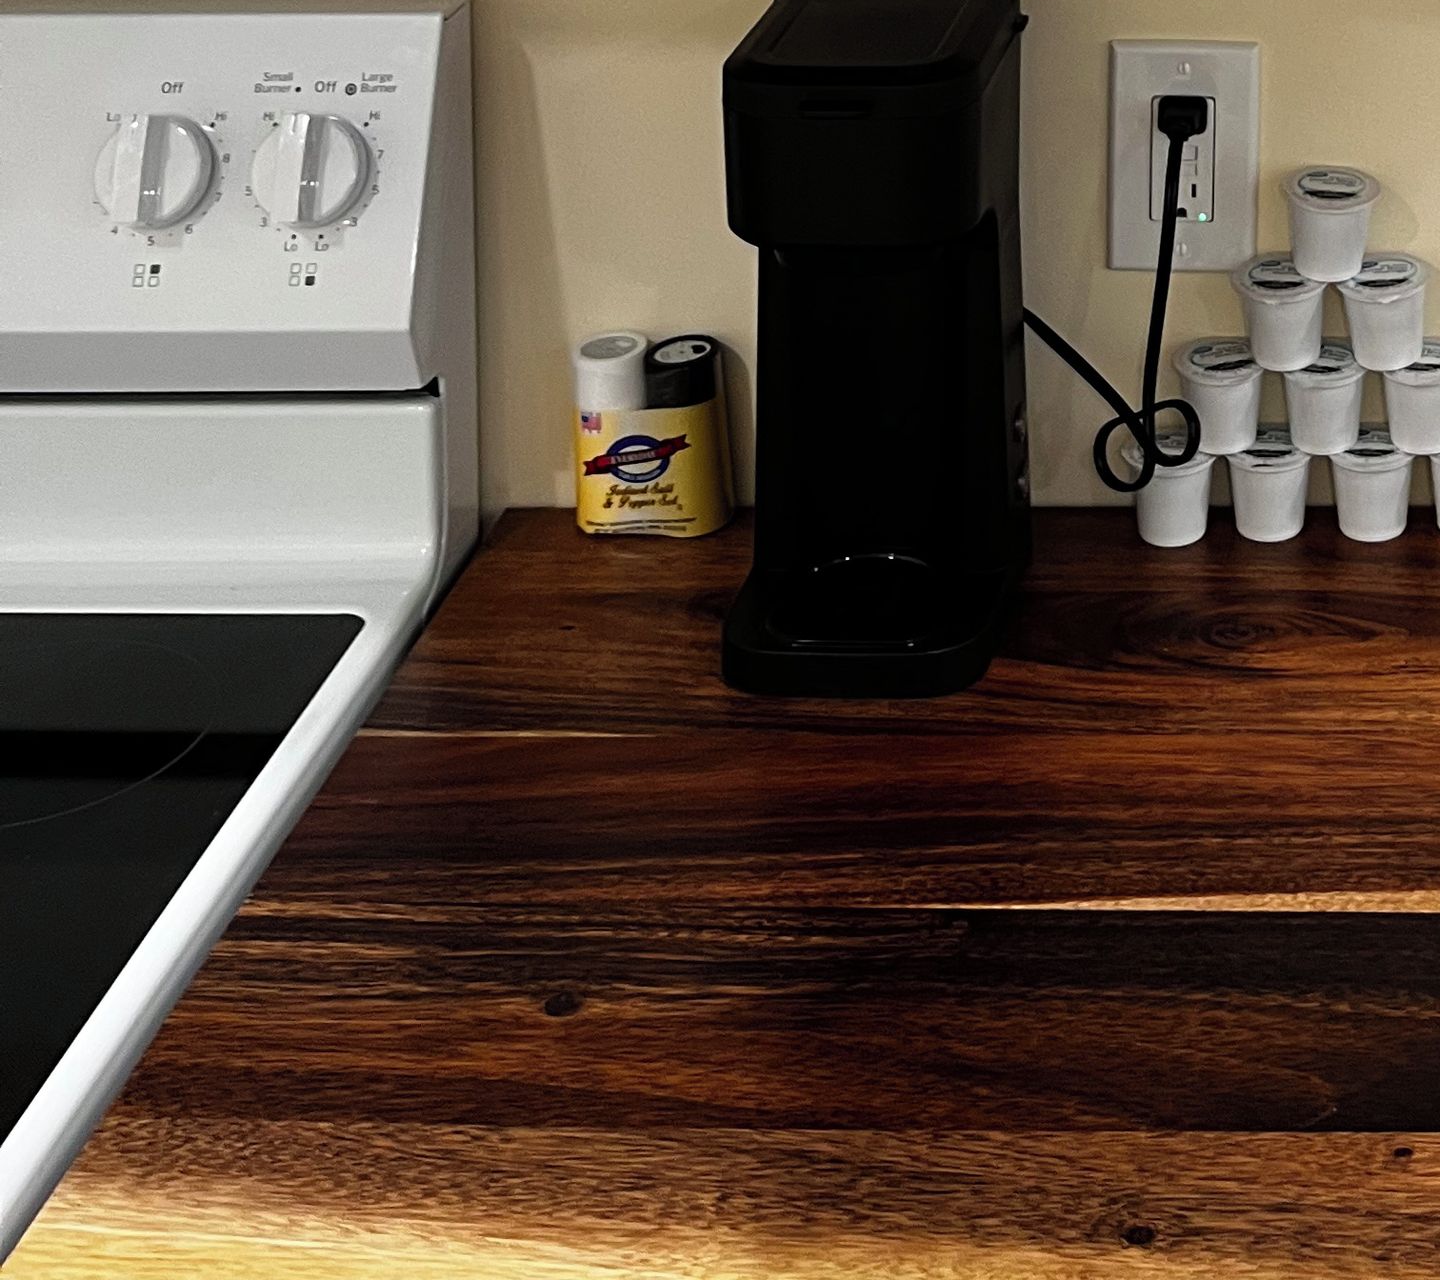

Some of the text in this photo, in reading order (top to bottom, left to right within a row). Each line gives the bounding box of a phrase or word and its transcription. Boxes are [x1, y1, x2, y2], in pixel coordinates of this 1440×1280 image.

[263, 72, 294, 82] Small
[362, 72, 394, 83] Large
[161, 81, 184, 94] Off
[254, 83, 292, 93] Burner
[314, 80, 338, 93] Off
[360, 83, 398, 93] Burner
[369, 110, 381, 120] Hi
[377, 149, 385, 159] 7
[184, 223, 193, 234] 6
[147, 236, 155, 246] 5
[284, 241, 298, 252] Lo
[315, 241, 329, 252] Lo
